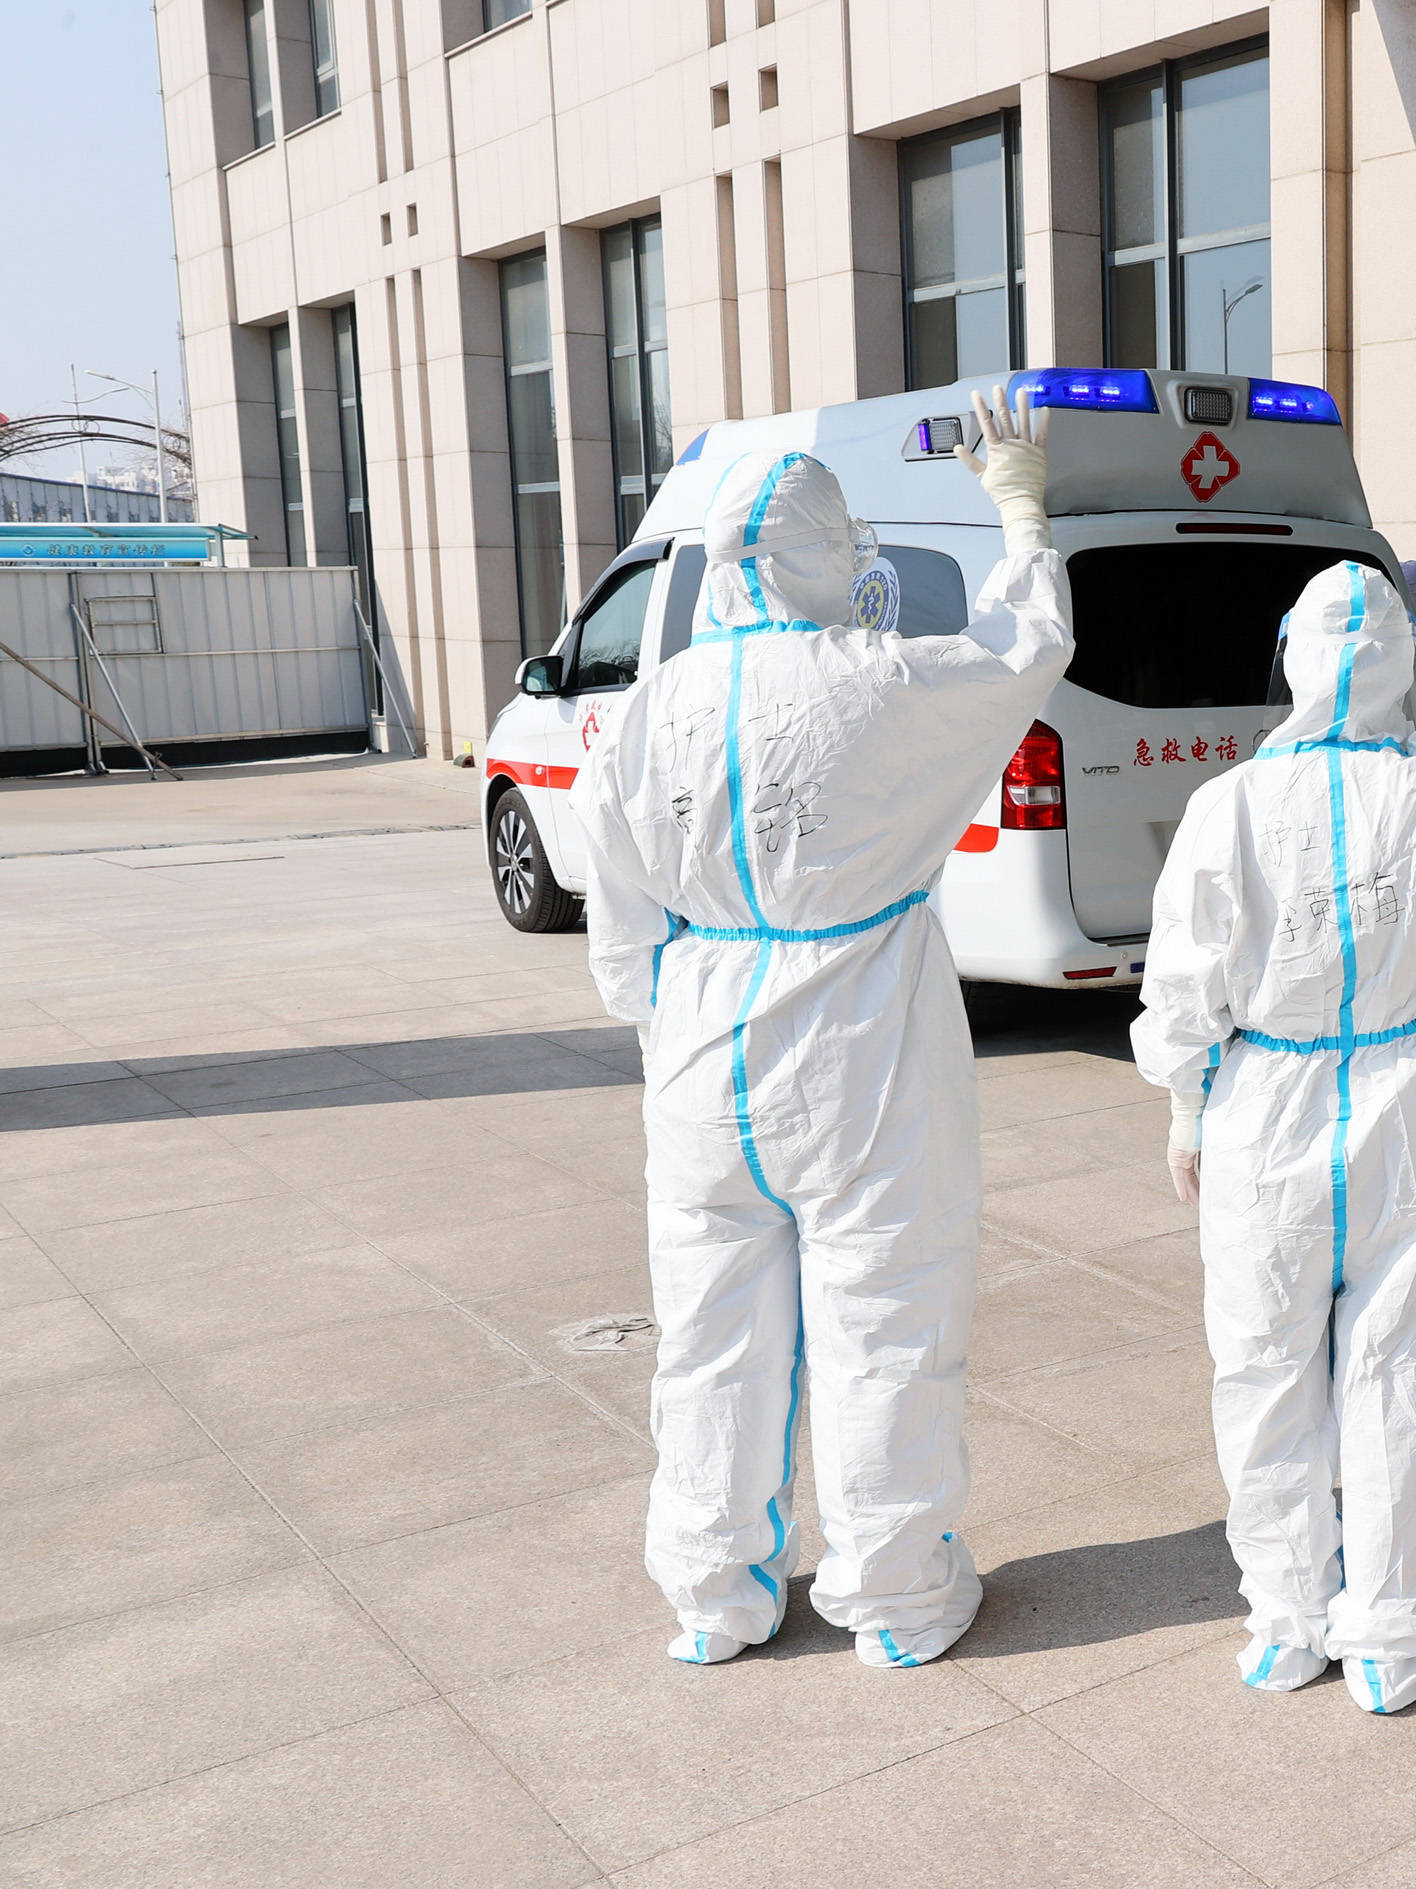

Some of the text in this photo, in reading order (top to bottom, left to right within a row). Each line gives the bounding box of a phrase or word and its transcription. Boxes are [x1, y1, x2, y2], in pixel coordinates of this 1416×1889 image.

[1133, 735, 1239, 767] 急救电话
[1082, 765, 1120, 776] VITO
[1258, 820, 1320, 867] 护士
